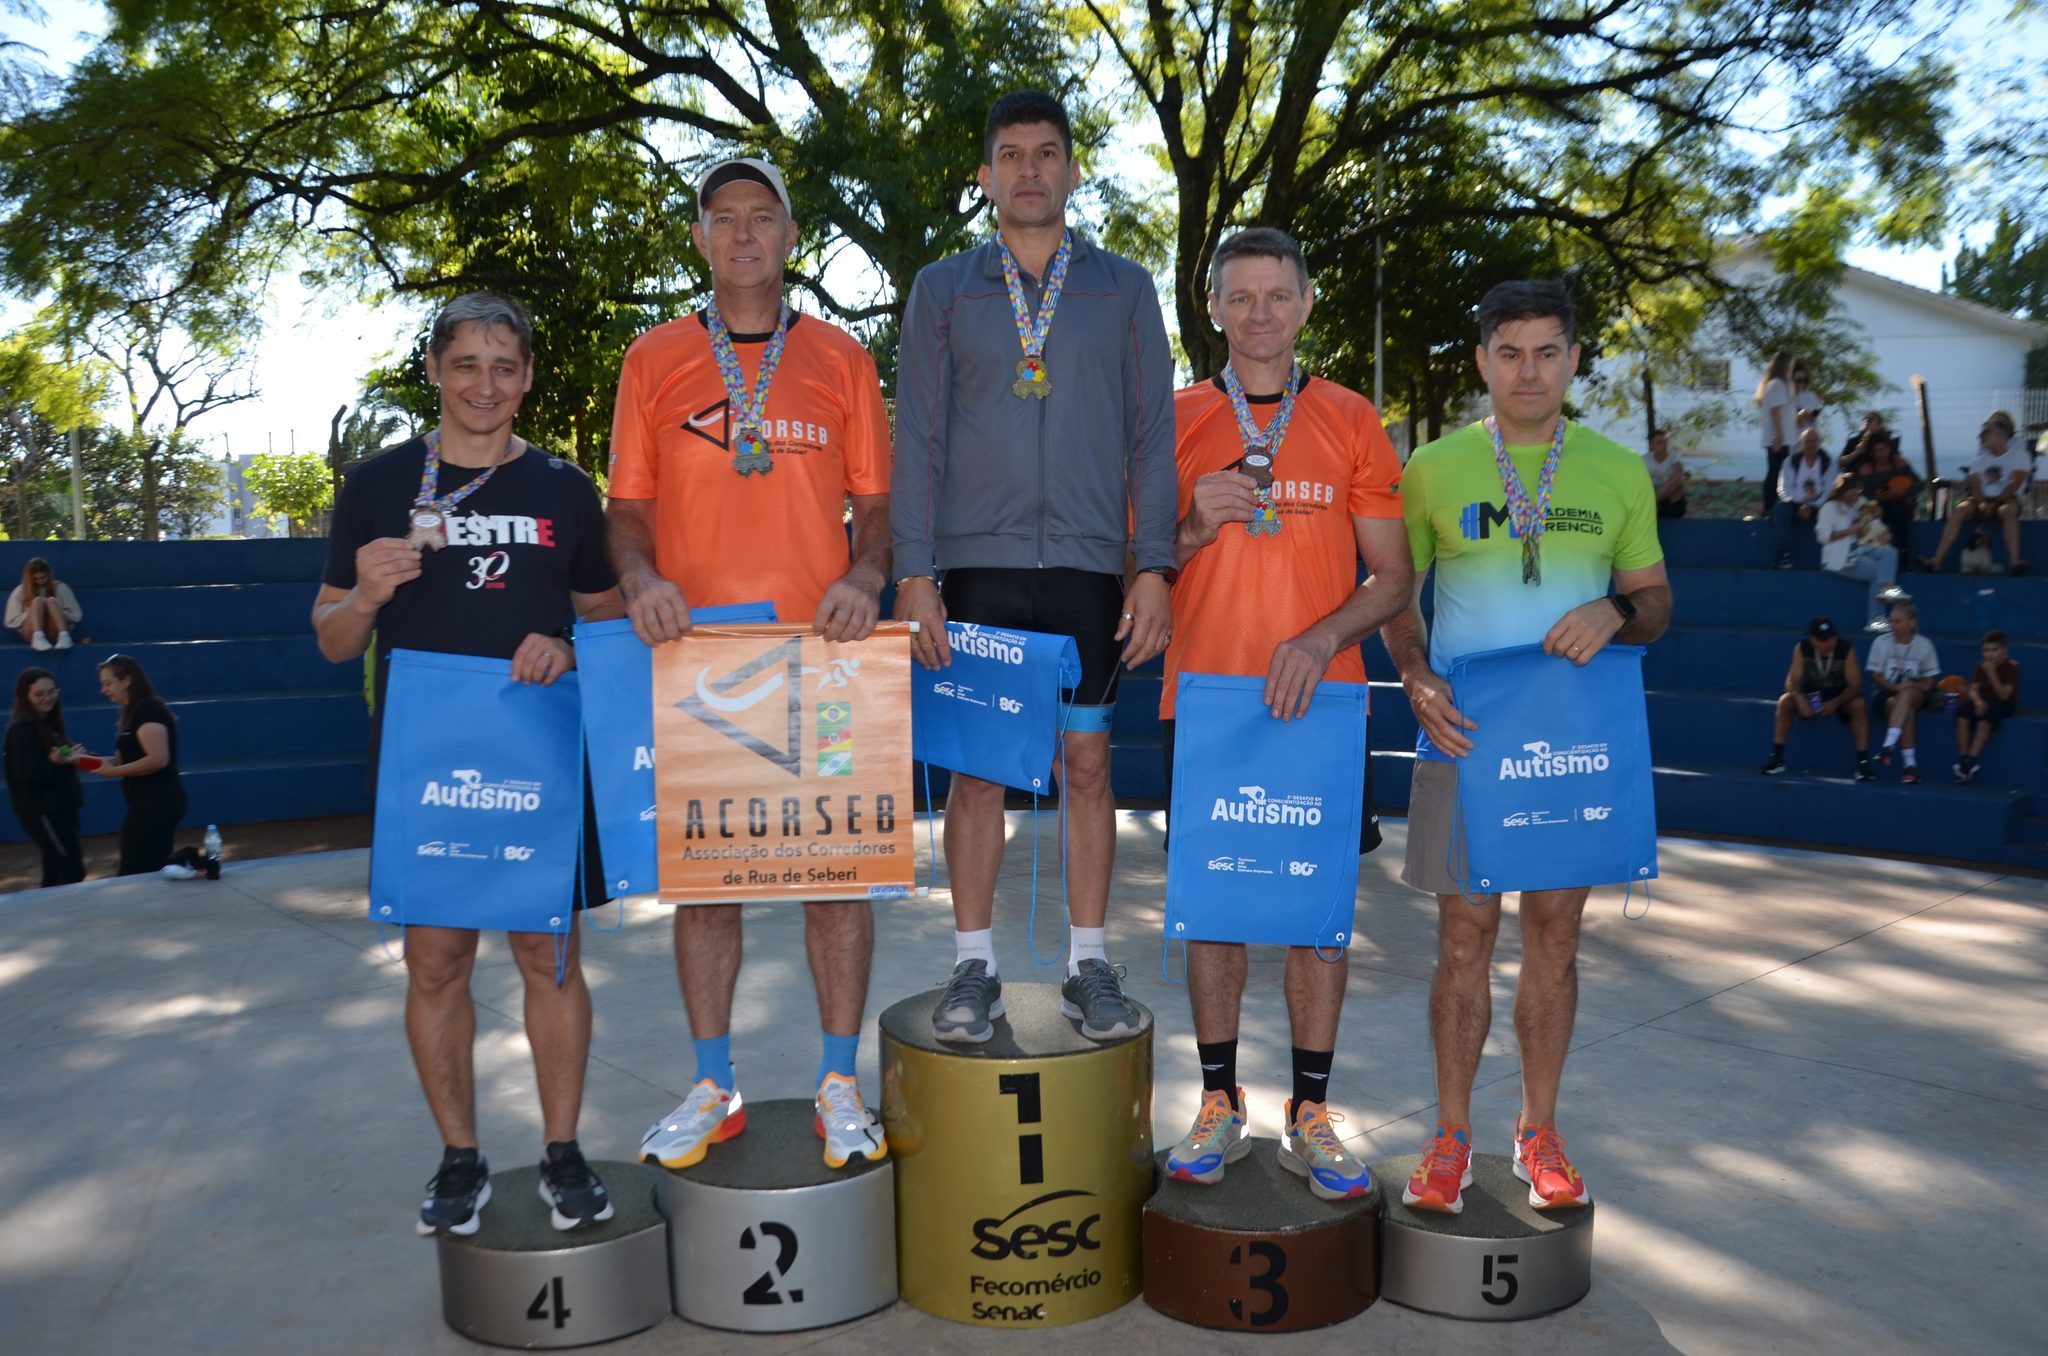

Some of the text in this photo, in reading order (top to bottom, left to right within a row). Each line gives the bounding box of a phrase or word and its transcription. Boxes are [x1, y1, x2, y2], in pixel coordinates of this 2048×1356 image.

[1271, 480, 1334, 503] ORSEB
[1545, 522, 1603, 536] RENCIO
[1546, 507, 1602, 520] ADEMIA
[442, 512, 556, 548] ESTRE
[465, 551, 511, 589] 30
[948, 630, 1023, 665] utismo
[1499, 754, 1609, 780] Autismo
[421, 781, 541, 812] Autismo
[685, 794, 895, 840] ACORSEB
[1210, 798, 1322, 827] Autismo
[682, 840, 896, 863] Associação dos Corredores
[723, 866, 857, 885] de Rua de Seberi
[999, 1072, 1044, 1185] 1
[739, 1221, 804, 1305] 2
[970, 1267, 1102, 1296] Fecomércio
[1229, 1240, 1289, 1326] 3
[1480, 1254, 1519, 1306] 5
[526, 1276, 572, 1330] 4
[972, 1302, 1046, 1321] Senac
